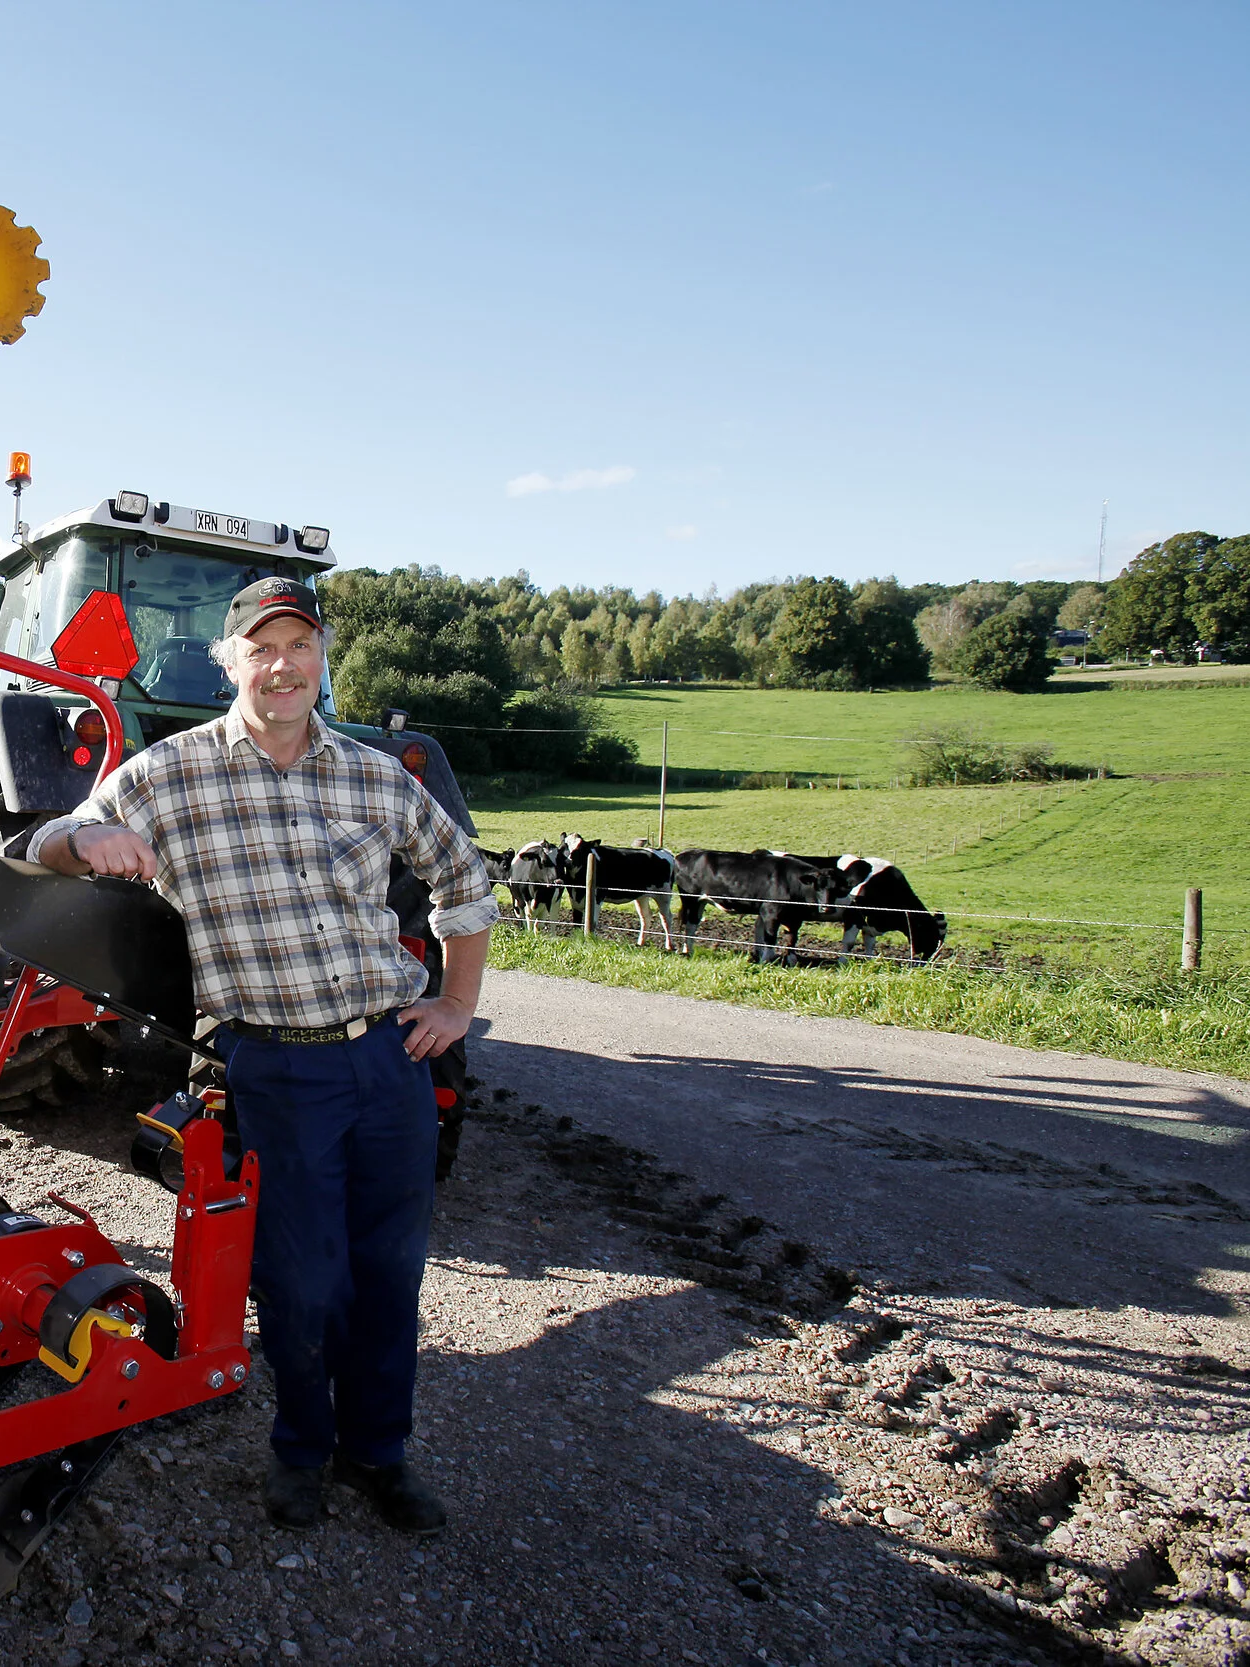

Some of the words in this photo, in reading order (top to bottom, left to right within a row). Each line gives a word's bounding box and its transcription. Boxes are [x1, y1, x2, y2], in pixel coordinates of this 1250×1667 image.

[197, 512, 218, 532] XRN
[226, 518, 247, 537] 094
[279, 1030, 345, 1043] SNICKERS
